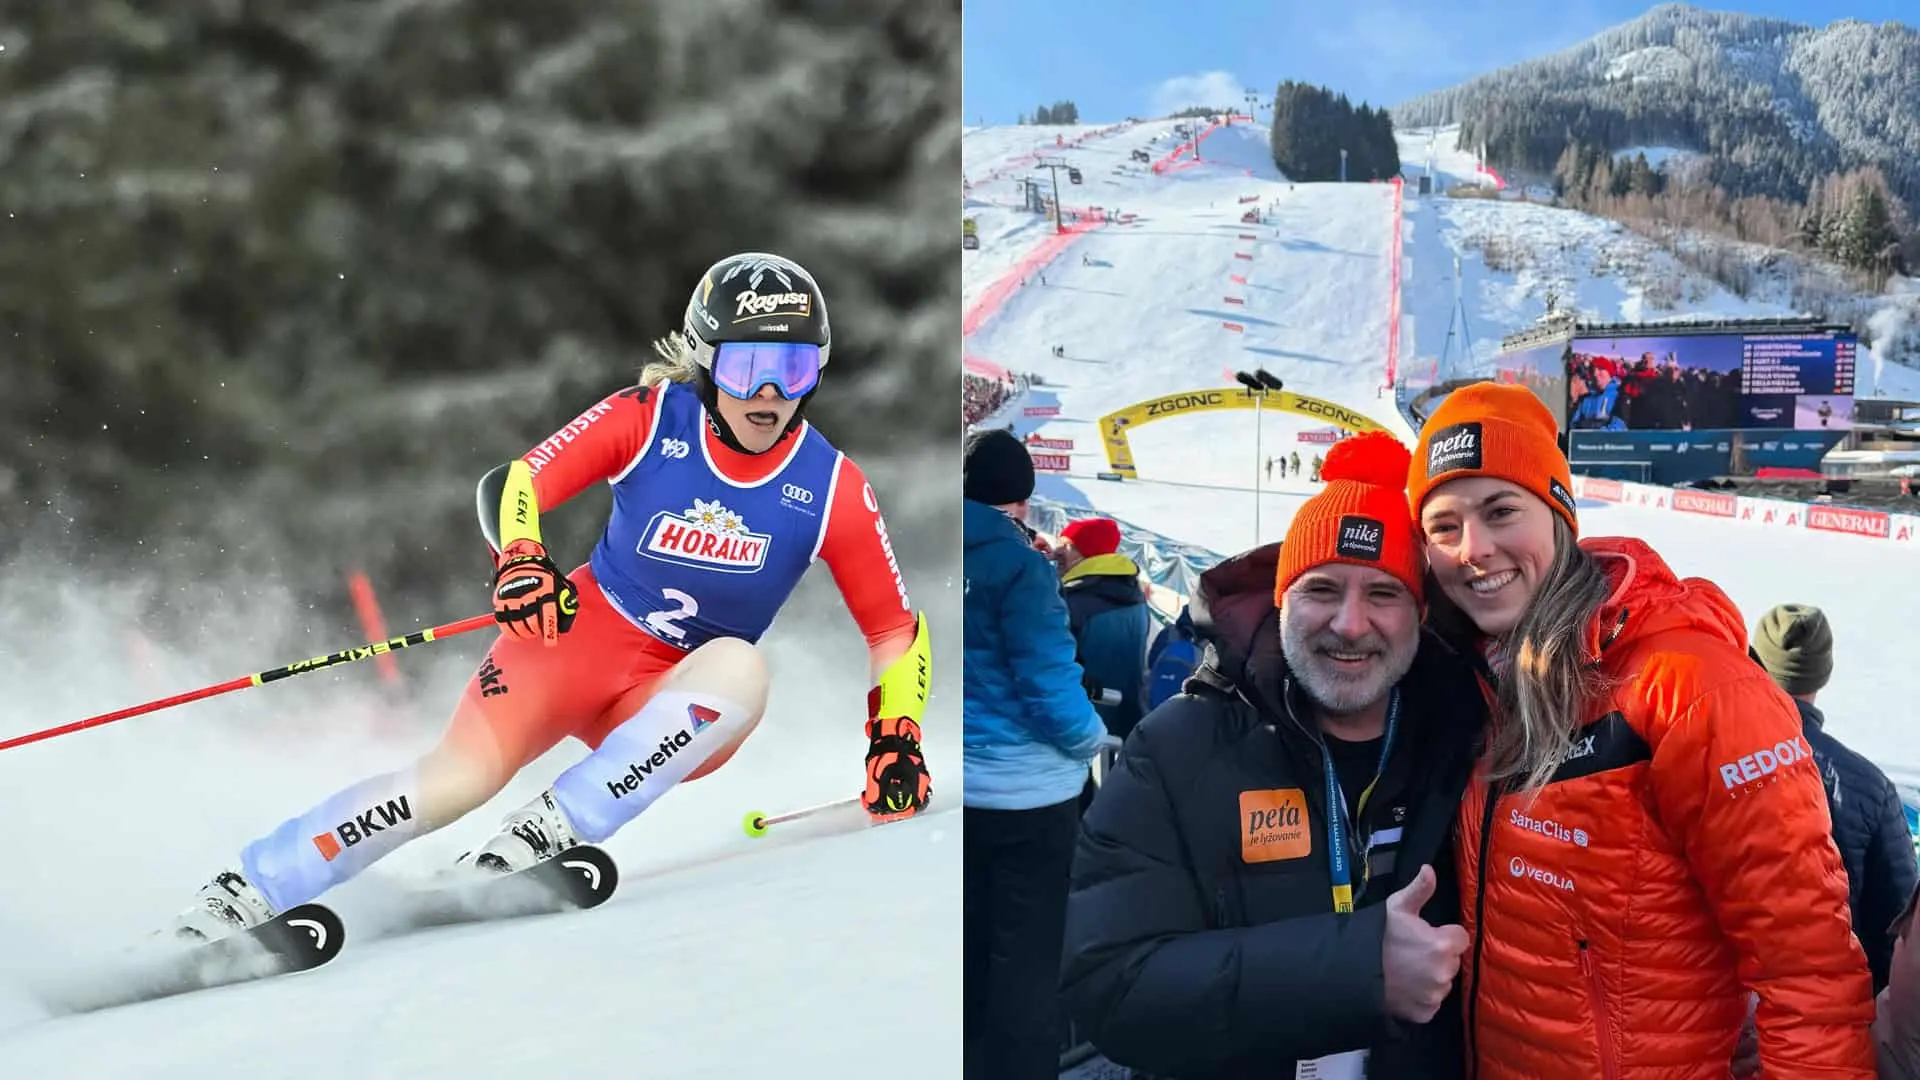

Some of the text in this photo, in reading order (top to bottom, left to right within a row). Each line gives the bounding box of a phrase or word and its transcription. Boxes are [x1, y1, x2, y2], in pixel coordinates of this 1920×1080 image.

[736, 290, 808, 316] Ragusa
[1145, 393, 1223, 416] ZGONC
[1295, 399, 1362, 427] ZGONC
[530, 400, 614, 477] AIFFEISEN
[1431, 428, 1475, 461] peťa
[1033, 456, 1067, 469] ERALI
[515, 490, 529, 525] LEKI
[1677, 496, 1734, 515] GENERALI
[1810, 511, 1886, 536] GENERALI
[660, 523, 762, 562] HORALKY
[1344, 524, 1379, 542] niké
[645, 588, 698, 640] 2
[917, 653, 926, 703] LEKI
[606, 729, 692, 800] helvetia
[1719, 735, 1809, 789] REDOX
[336, 795, 413, 848] BKW
[1249, 799, 1301, 835] peťa
[1510, 808, 1571, 842] SanaClis
[1526, 866, 1575, 892] VEOLIA
